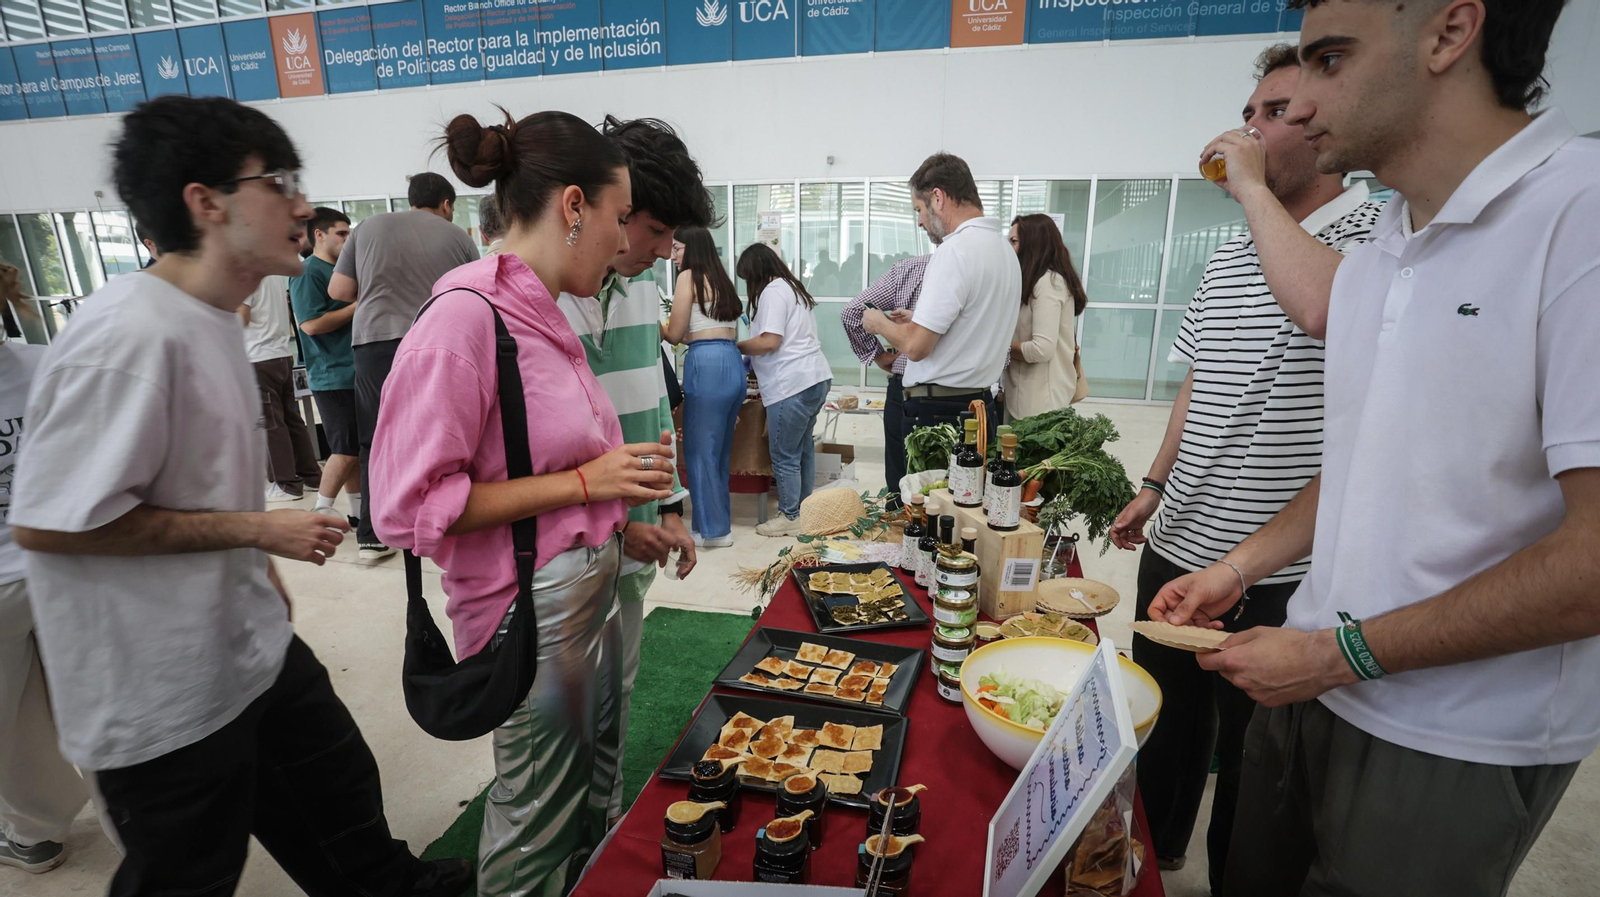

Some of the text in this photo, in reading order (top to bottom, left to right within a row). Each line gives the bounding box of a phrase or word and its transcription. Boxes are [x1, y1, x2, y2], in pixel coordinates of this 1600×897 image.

[444, 4, 467, 13] Rector
[738, 0, 789, 23] UCA
[807, 6, 849, 17] de Cádiz
[969, 0, 1008, 11] UCA
[1103, 4, 1182, 22] Inspección
[1187, 0, 1246, 16] General
[1251, 0, 1269, 13] de
[967, 16, 1007, 24] Universidad
[1037, 21, 1197, 38] General Inspection of Services
[108, 44, 130, 52] Campus
[325, 18, 660, 66] Delegación del Rector para la Implementación
[230, 51, 266, 61] Universidad
[286, 56, 311, 69] UCA
[377, 61, 394, 78] de
[397, 55, 456, 76] Políticas
[460, 54, 478, 70] de
[481, 47, 546, 72] Igualdad
[551, 49, 559, 66] y
[564, 45, 584, 61] de
[589, 38, 661, 59] Inclusión
[185, 57, 219, 75] UCA
[241, 61, 259, 70] Cádiz
[0, 83, 13, 95] tor
[40, 77, 50, 92] el
[51, 76, 95, 92] Campus
[95, 72, 111, 87] de
[114, 71, 141, 86] Jerez
[1349, 632, 1385, 676] RENZO 2023
